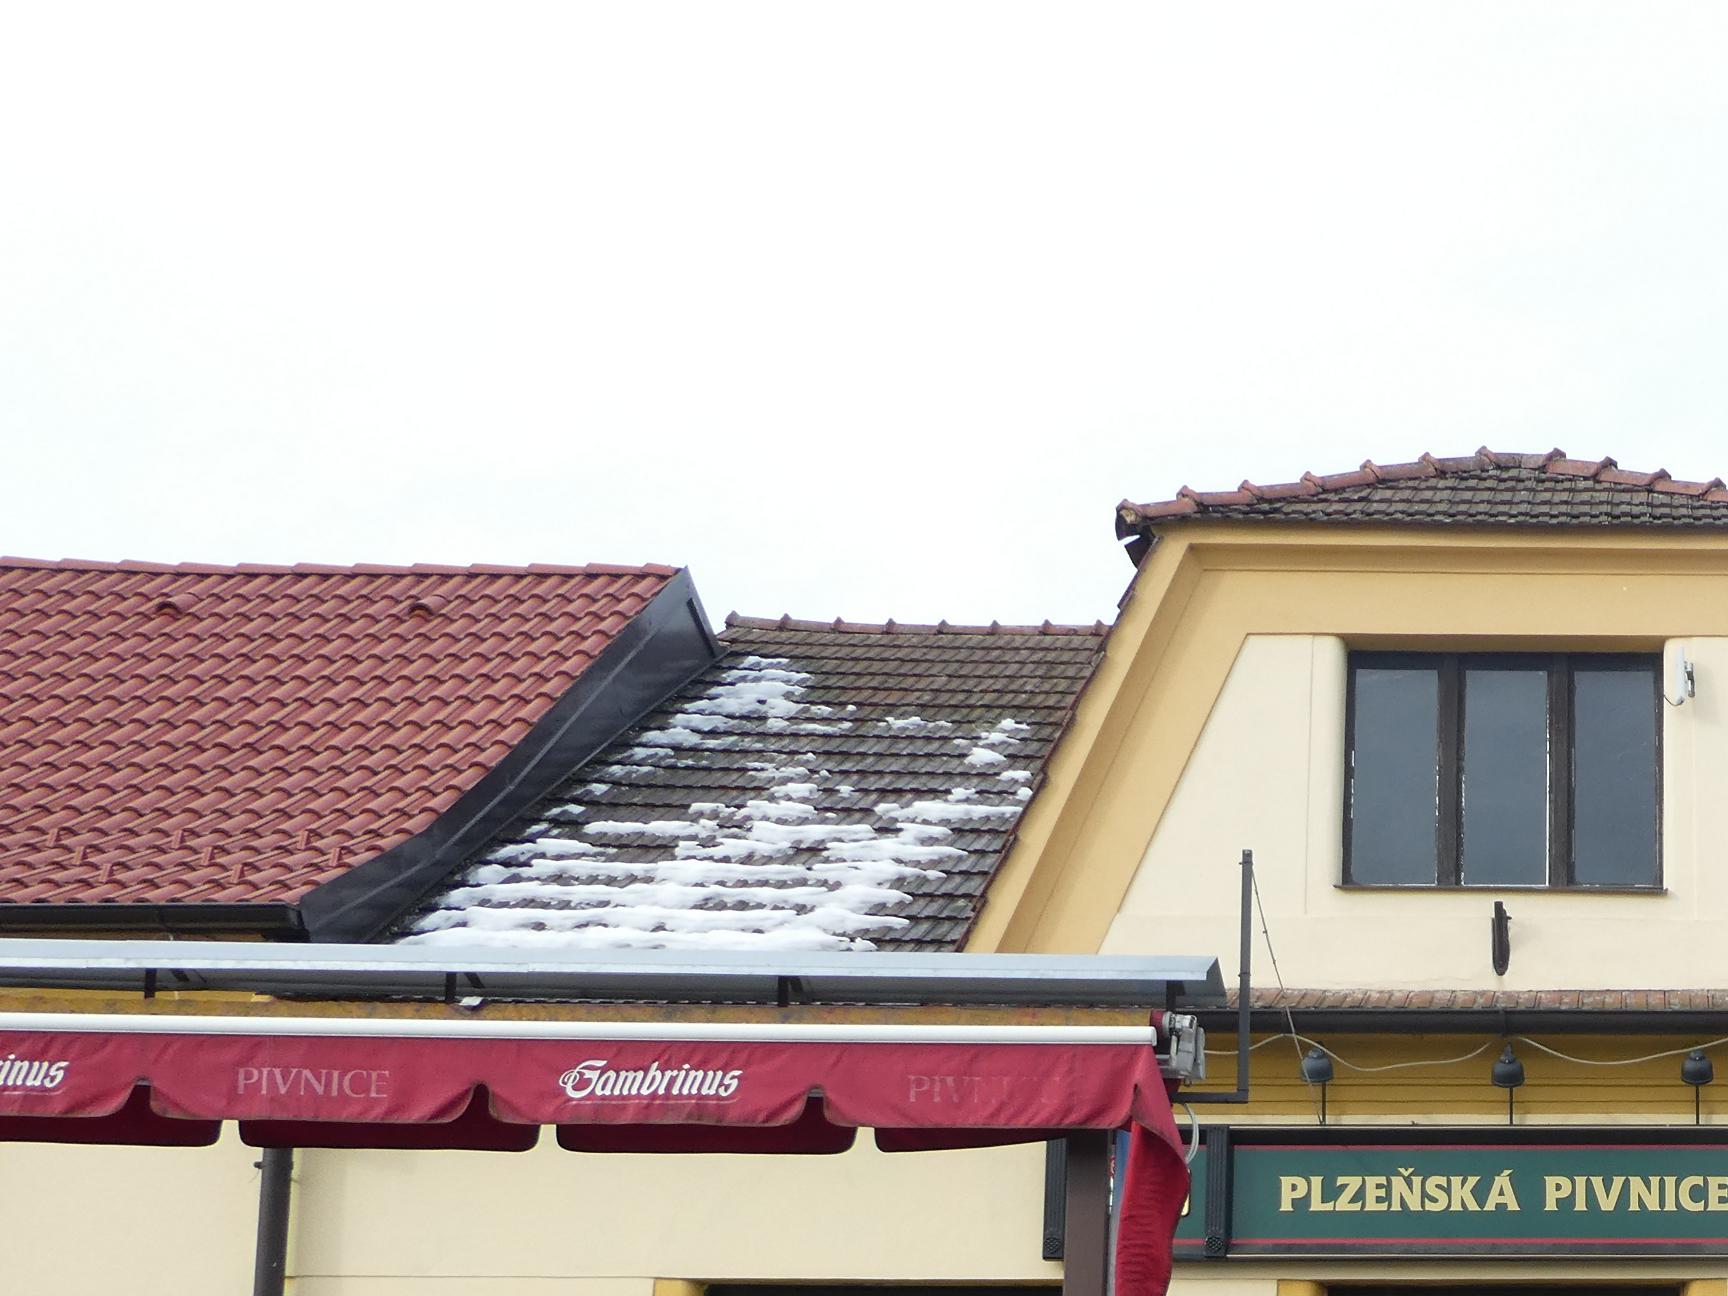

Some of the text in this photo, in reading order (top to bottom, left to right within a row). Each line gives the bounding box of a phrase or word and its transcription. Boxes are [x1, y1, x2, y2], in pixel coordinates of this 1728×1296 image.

[236, 1066, 391, 1098] PIVNICE
[558, 1059, 744, 1099] Gambrinus
[1278, 1167, 1521, 1212] PLZEŇSKÁ
